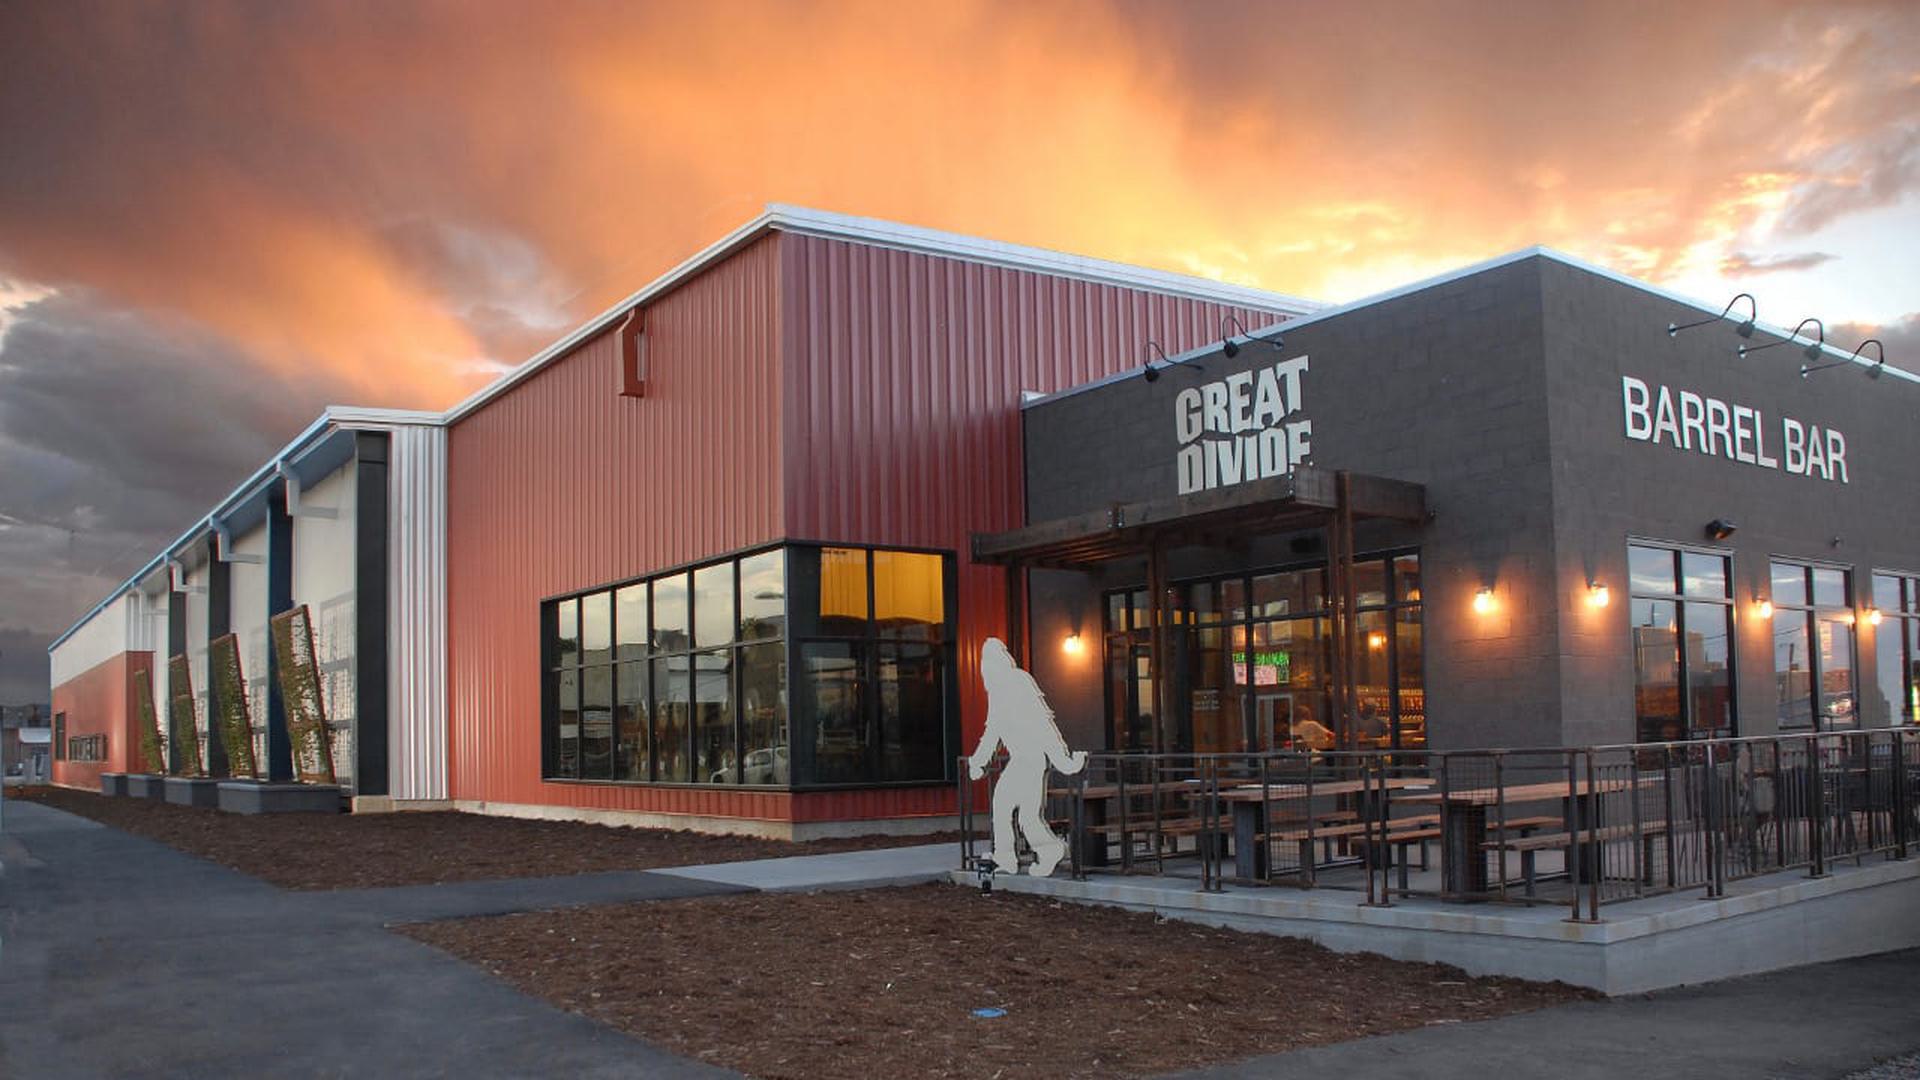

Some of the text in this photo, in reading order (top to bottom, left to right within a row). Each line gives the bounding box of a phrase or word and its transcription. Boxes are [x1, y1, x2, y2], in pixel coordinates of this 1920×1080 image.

[1175, 355, 1309, 444] GREAT
[1622, 375, 1849, 484] BARREL BAR
[1177, 420, 1312, 495] DIVIDE
